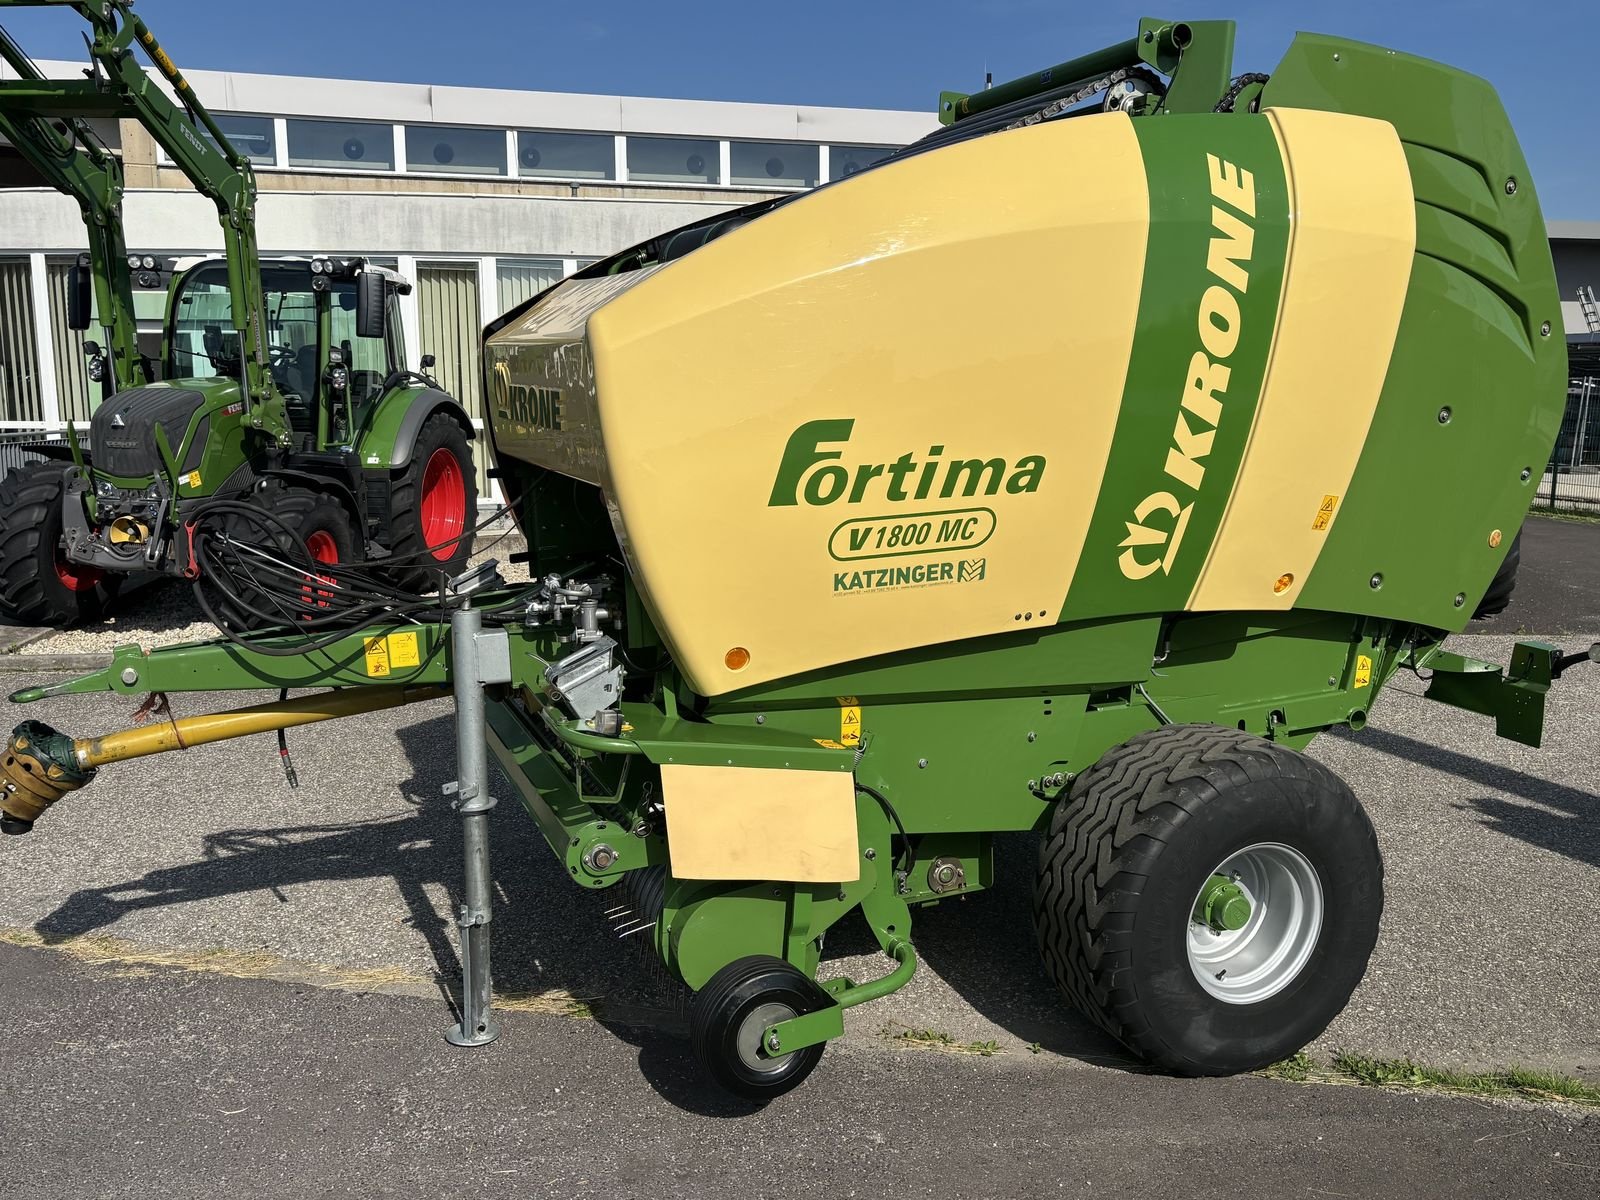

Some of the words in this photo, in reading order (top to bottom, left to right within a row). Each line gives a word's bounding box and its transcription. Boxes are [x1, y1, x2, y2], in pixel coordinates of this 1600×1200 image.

[180, 122, 208, 156] FENDT
[1164, 152, 1257, 491] KRONE
[509, 385, 563, 431] KRONE
[768, 418, 1047, 506] Fortima
[849, 527, 873, 552] V
[875, 521, 932, 549] 1800
[936, 517, 978, 543] MC
[833, 562, 954, 592] KATZINGER
